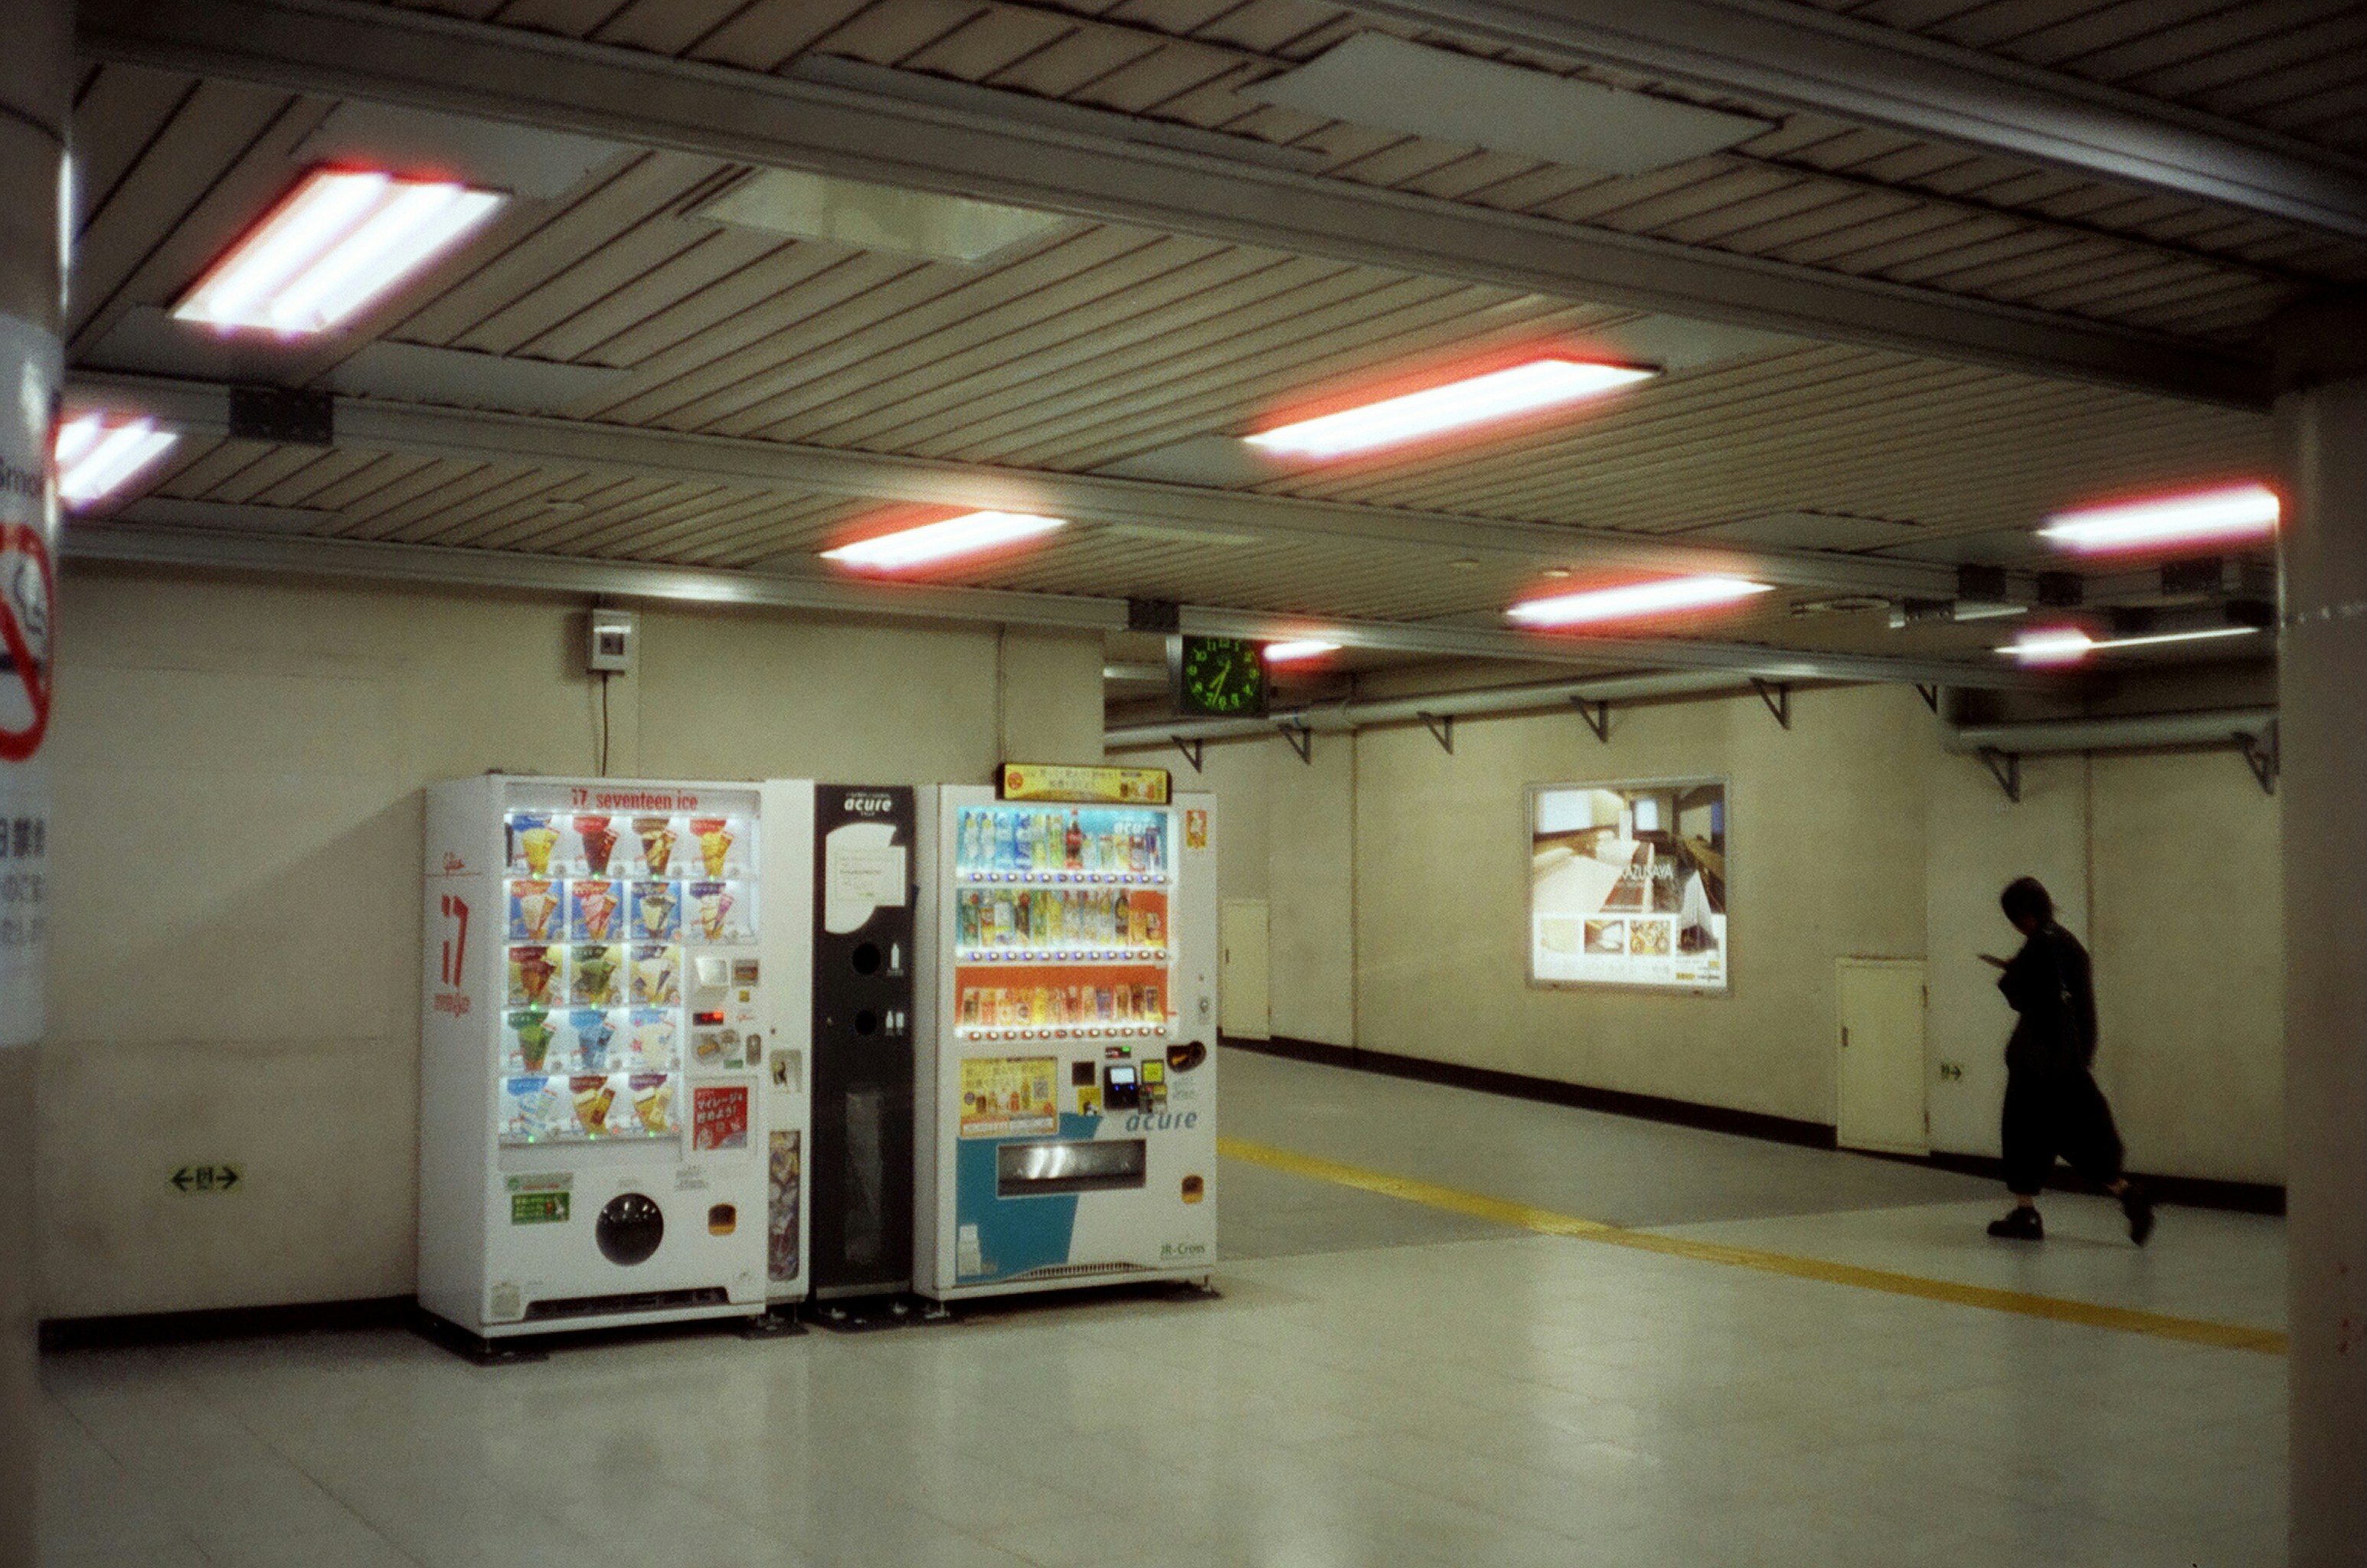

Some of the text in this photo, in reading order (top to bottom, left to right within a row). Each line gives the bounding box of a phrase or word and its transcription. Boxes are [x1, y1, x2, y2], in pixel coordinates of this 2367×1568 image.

[596, 792, 672, 810] seventeen
[677, 789, 698, 810] ice
[844, 798, 891, 812] acure
[1125, 1112, 1198, 1132] acure
